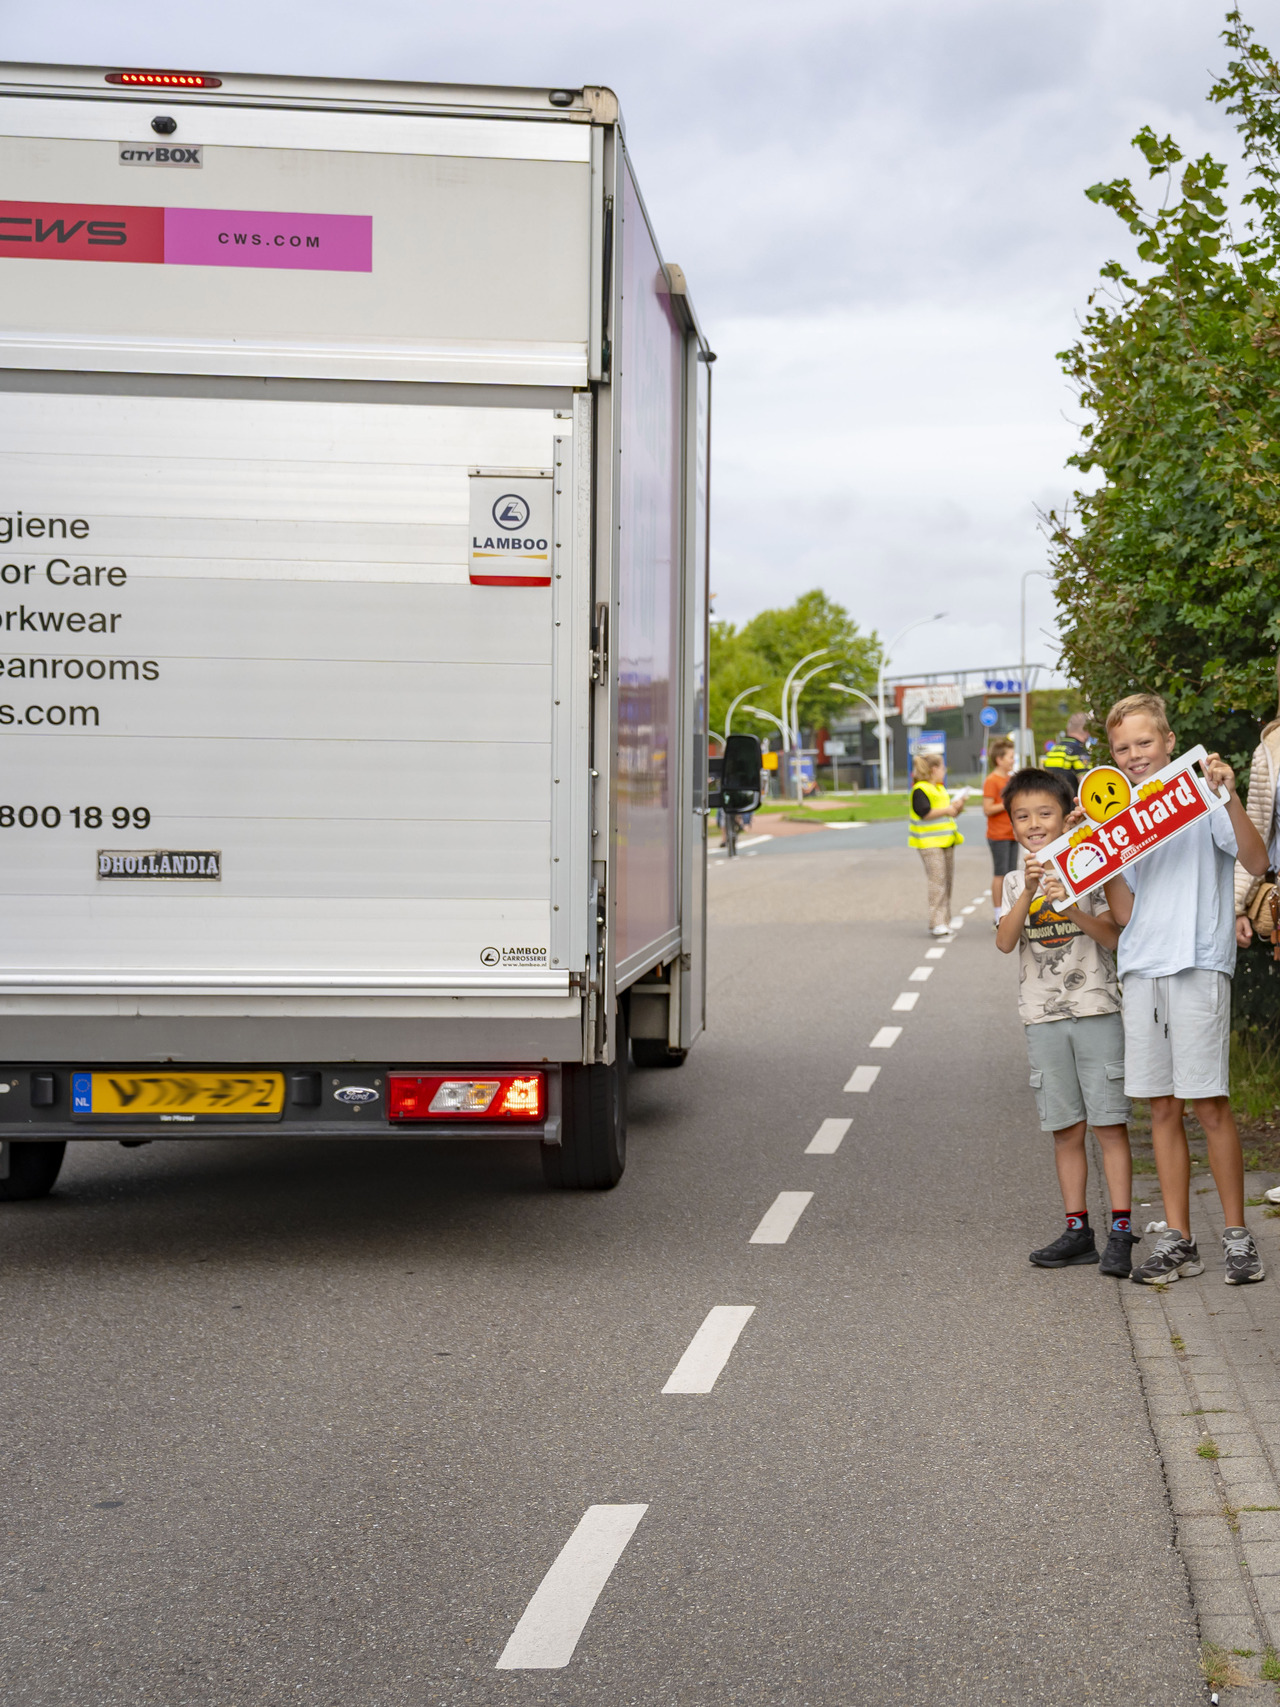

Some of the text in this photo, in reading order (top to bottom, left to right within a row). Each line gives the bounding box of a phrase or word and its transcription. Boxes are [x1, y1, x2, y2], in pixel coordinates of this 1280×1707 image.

[0, 217, 127, 246] CWS
[217, 232, 321, 248] CWS.COM
[472, 537, 548, 550] LAMBOO
[0, 558, 127, 587] or Care
[0, 605, 122, 634] rkwear
[0, 657, 160, 681] anrooms
[0, 704, 100, 726] s.com
[0, 805, 151, 830] 800 18 99
[1098, 776, 1197, 857] te hard
[99, 855, 219, 876] DHOLLANDIA
[502, 947, 547, 955] LAMBOO
[75, 1097, 90, 1107] NL
[343, 1090, 370, 1101] Ford
